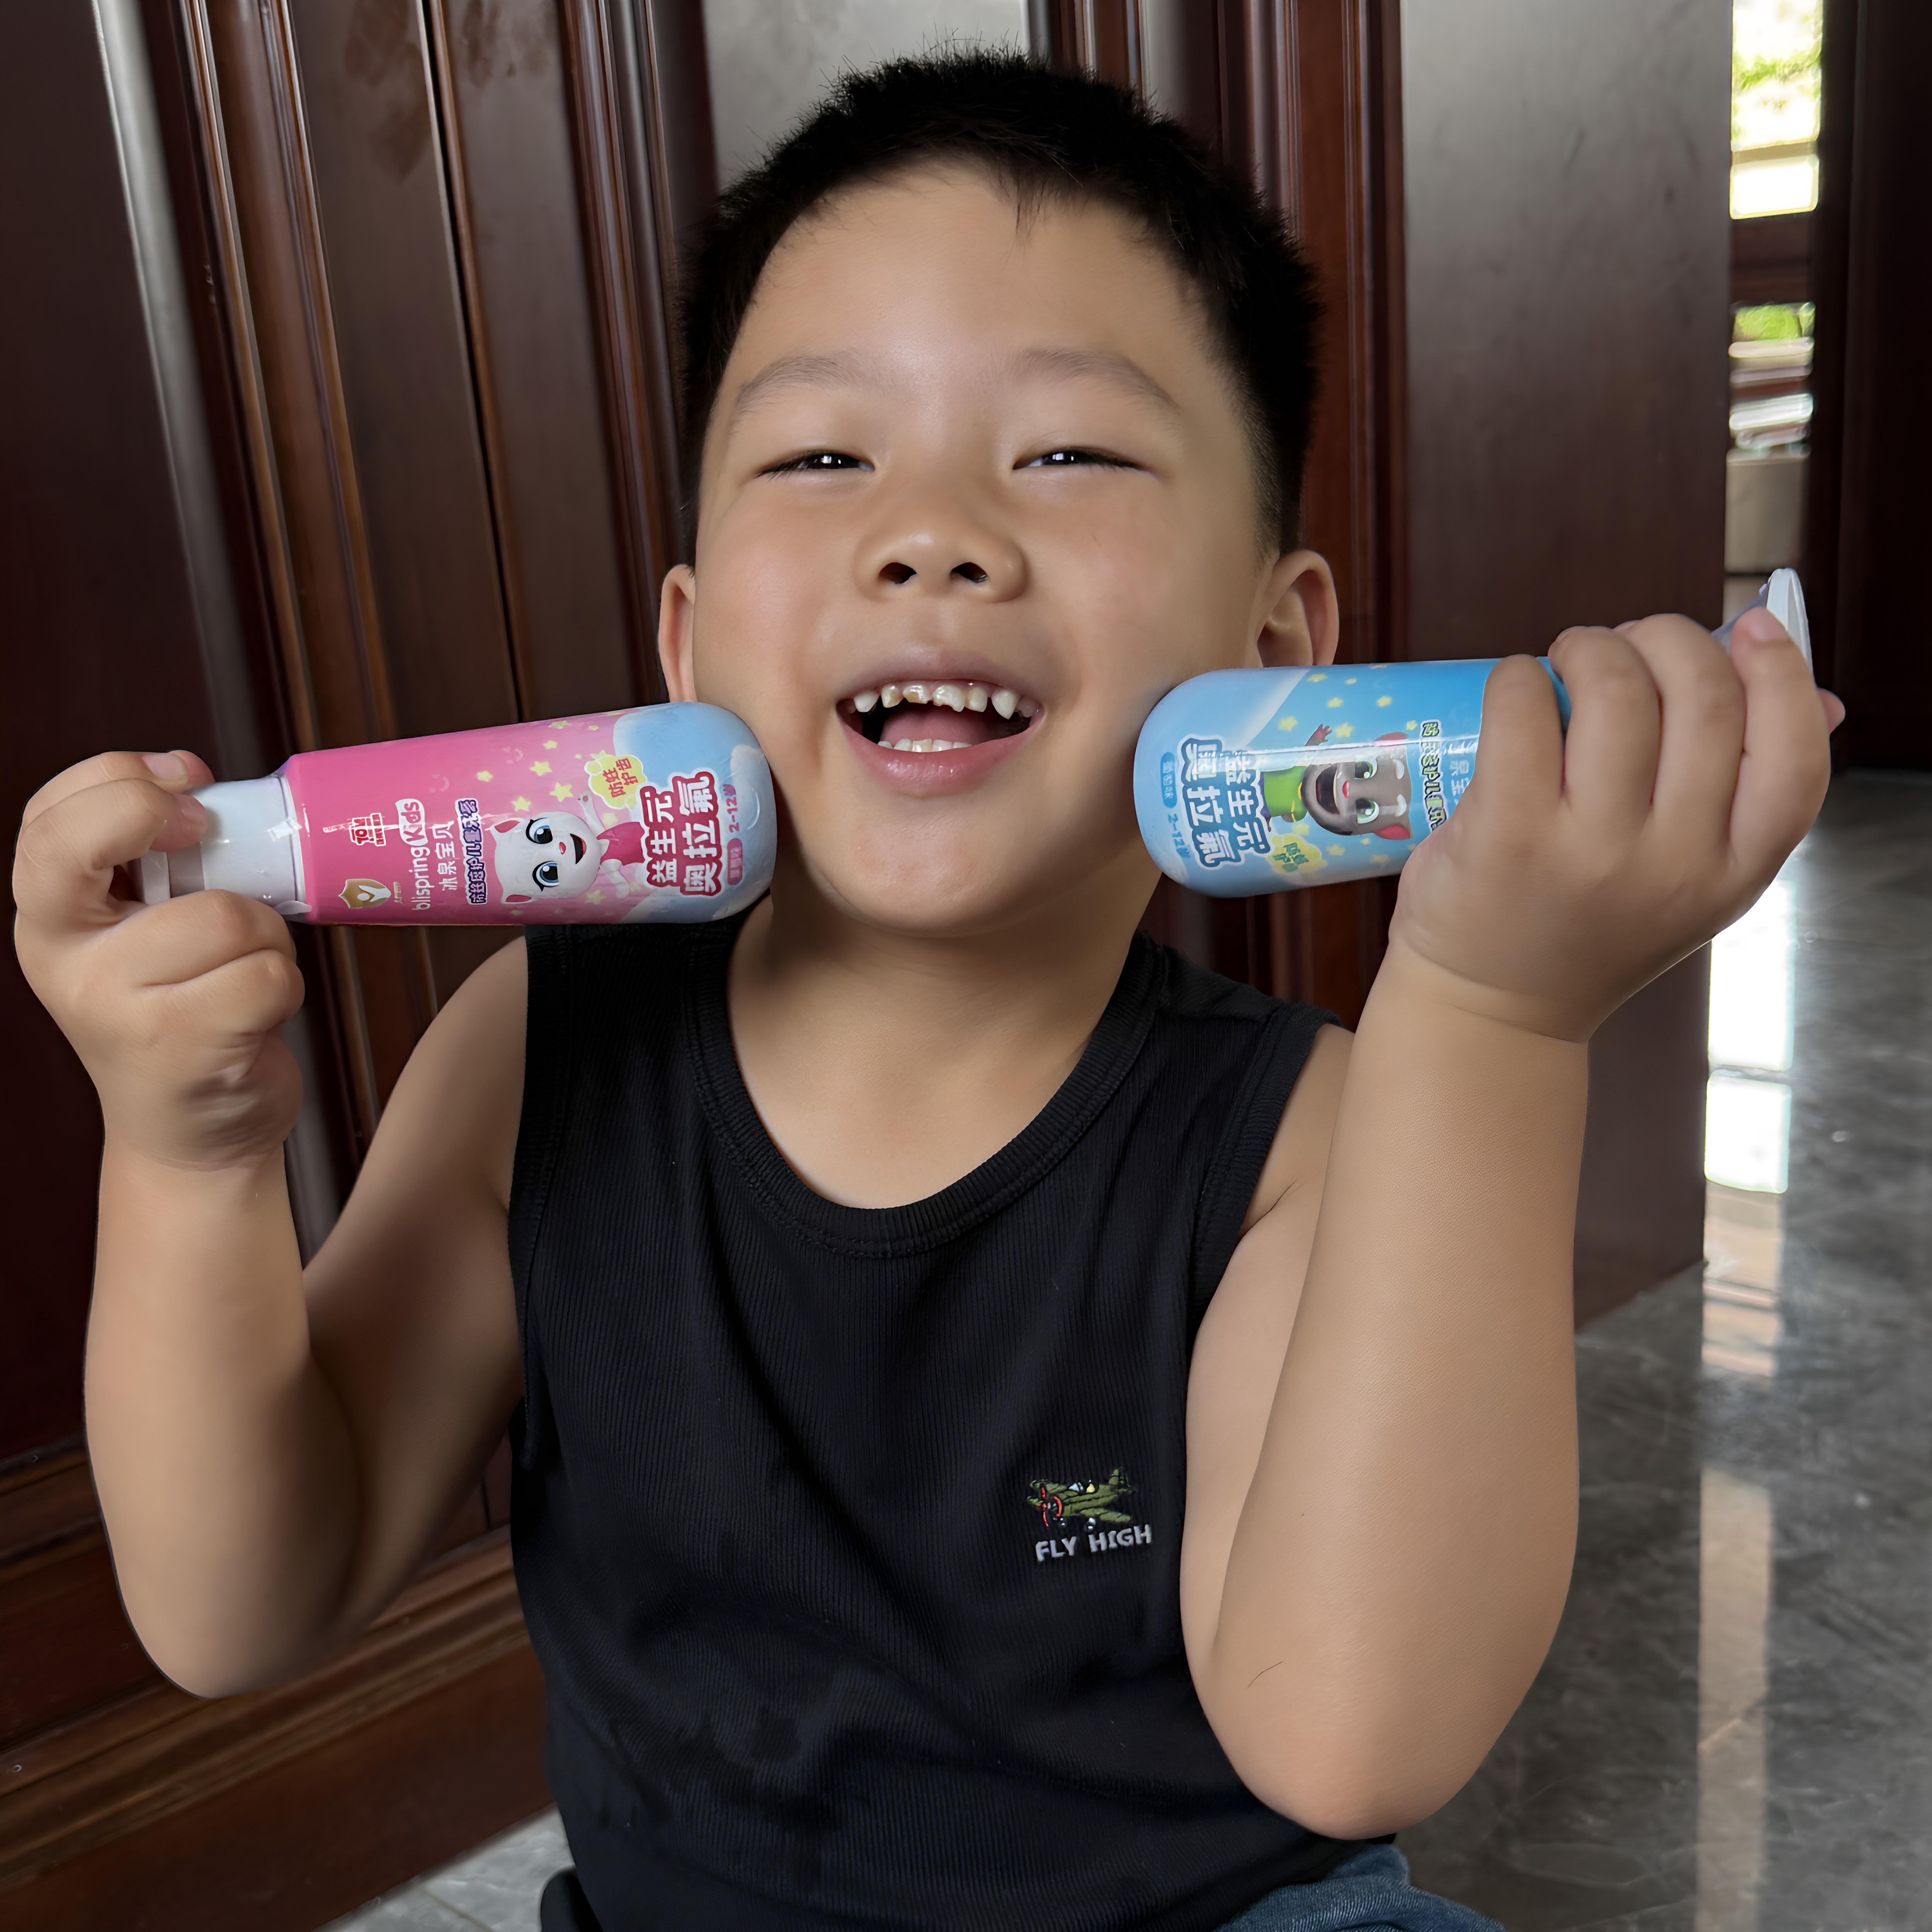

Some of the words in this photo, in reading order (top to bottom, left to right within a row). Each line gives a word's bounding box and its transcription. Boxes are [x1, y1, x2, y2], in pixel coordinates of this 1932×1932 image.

[602, 767, 626, 797] 防蛀
[616, 758, 638, 785] 护齿
[1186, 744, 1235, 863] 奥拉氟
[1225, 753, 1264, 849] 益生元
[401, 801, 425, 842] Kids
[645, 791, 677, 882] 益生元
[677, 776, 717, 892] 奥拉氟
[1036, 1536, 1077, 1562] FLY
[1088, 1524, 1152, 1553] HIGH
